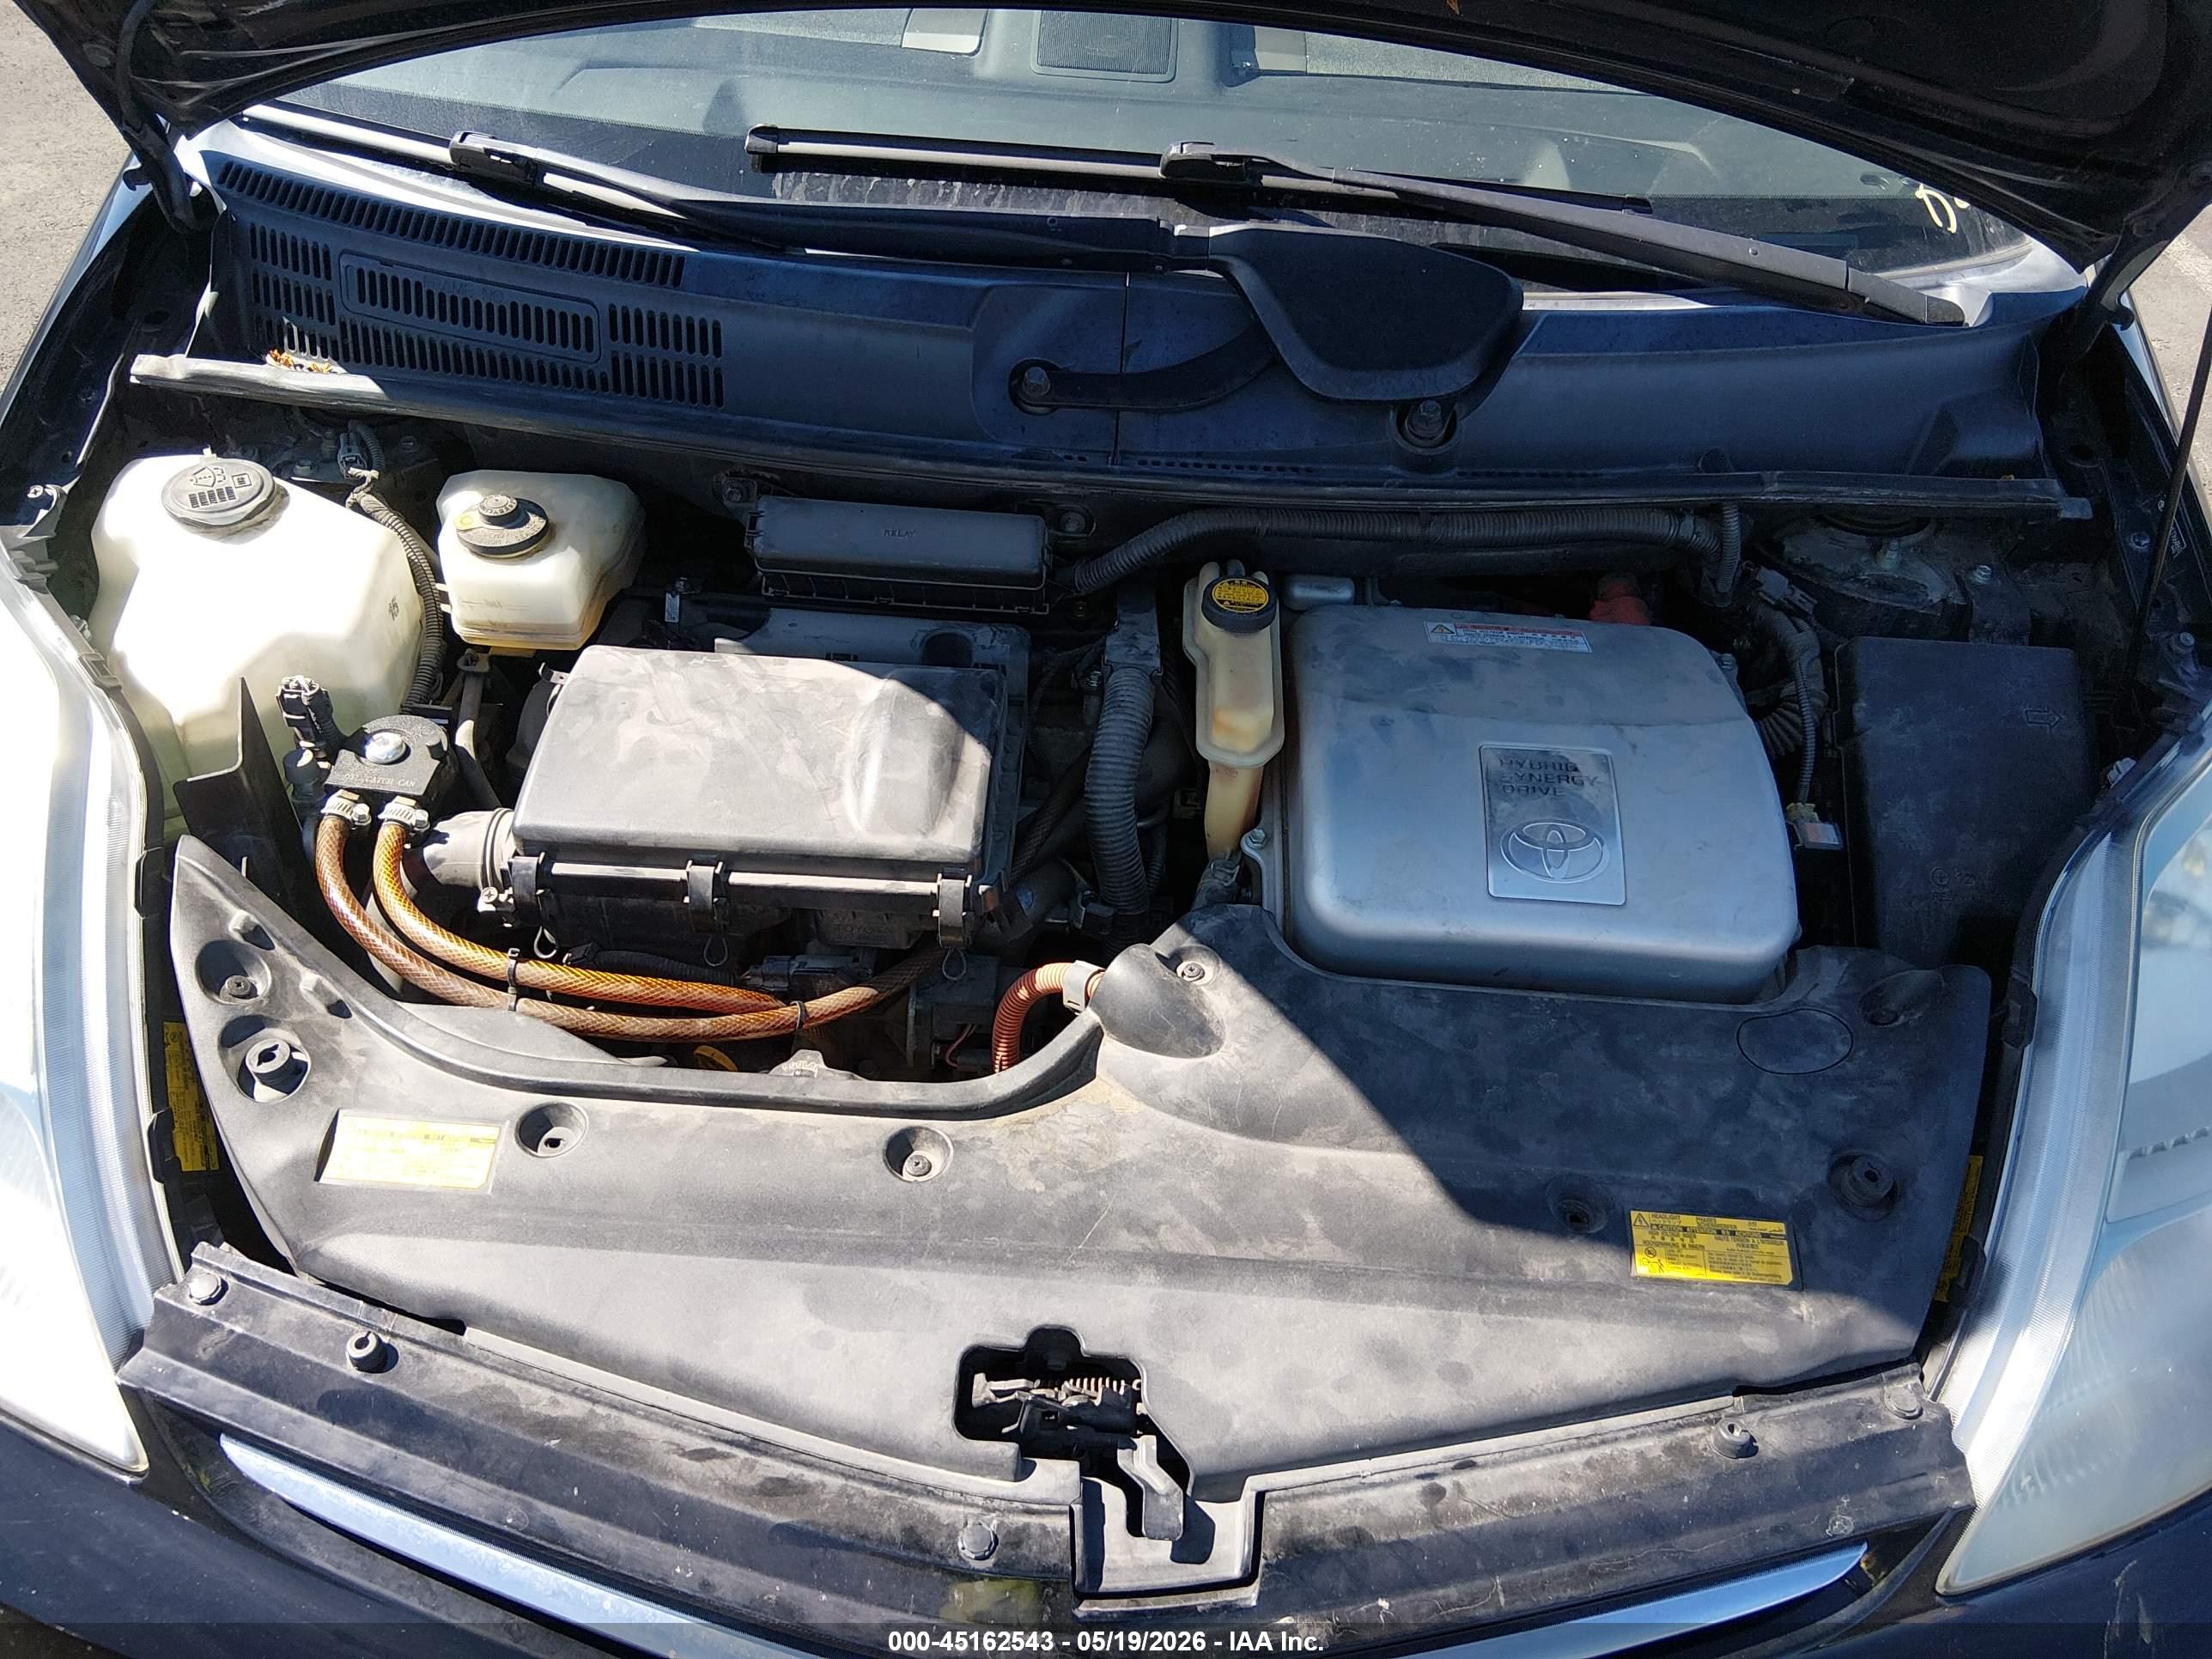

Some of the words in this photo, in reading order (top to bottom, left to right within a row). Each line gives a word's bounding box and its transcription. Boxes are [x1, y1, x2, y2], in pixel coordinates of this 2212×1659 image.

[884, 528, 916, 538] RELAY
[1499, 758, 1580, 773] HYBRID
[398, 779, 416, 787] CAN
[1502, 772, 1599, 787] SYNERGY
[1503, 783, 1566, 797] DRIVE
